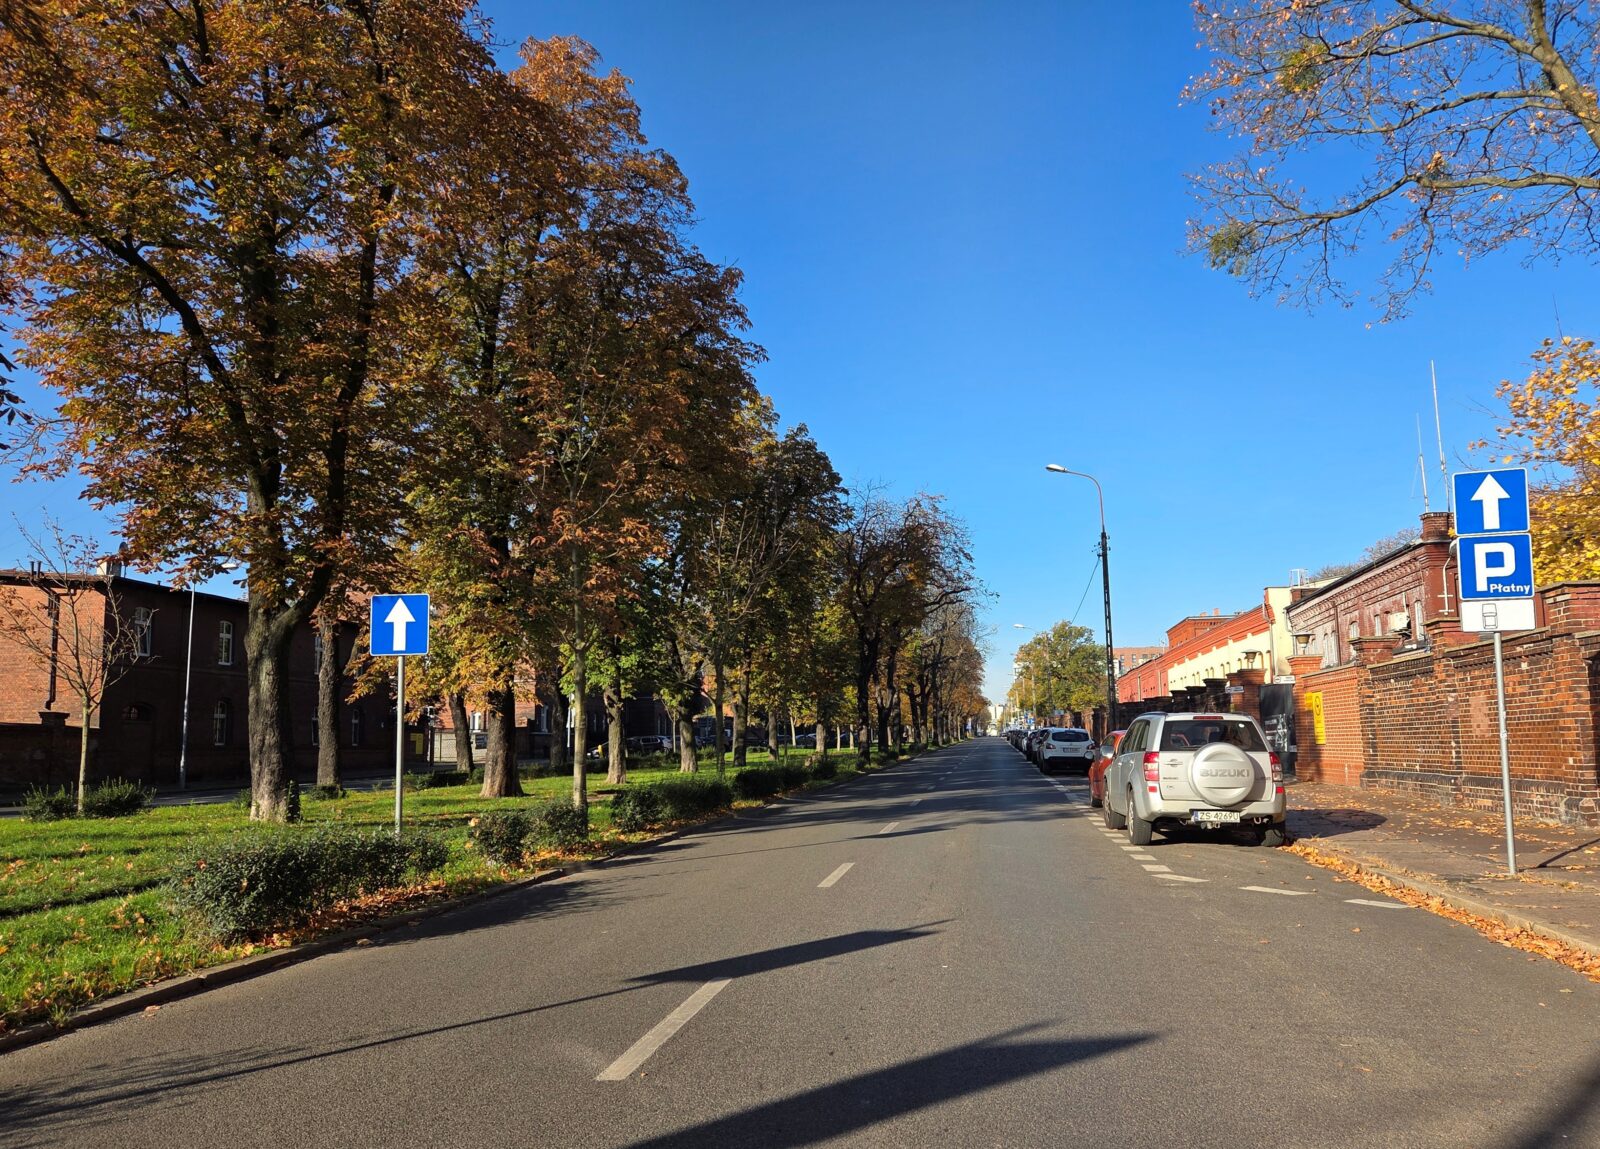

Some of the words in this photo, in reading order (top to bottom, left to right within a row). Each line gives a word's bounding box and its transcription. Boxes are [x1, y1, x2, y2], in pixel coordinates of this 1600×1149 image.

[1474, 542, 1516, 592] P
[1490, 583, 1530, 594] Płatny
[1200, 768, 1250, 777] SUZUKI
[1199, 812, 1211, 820] ZS
